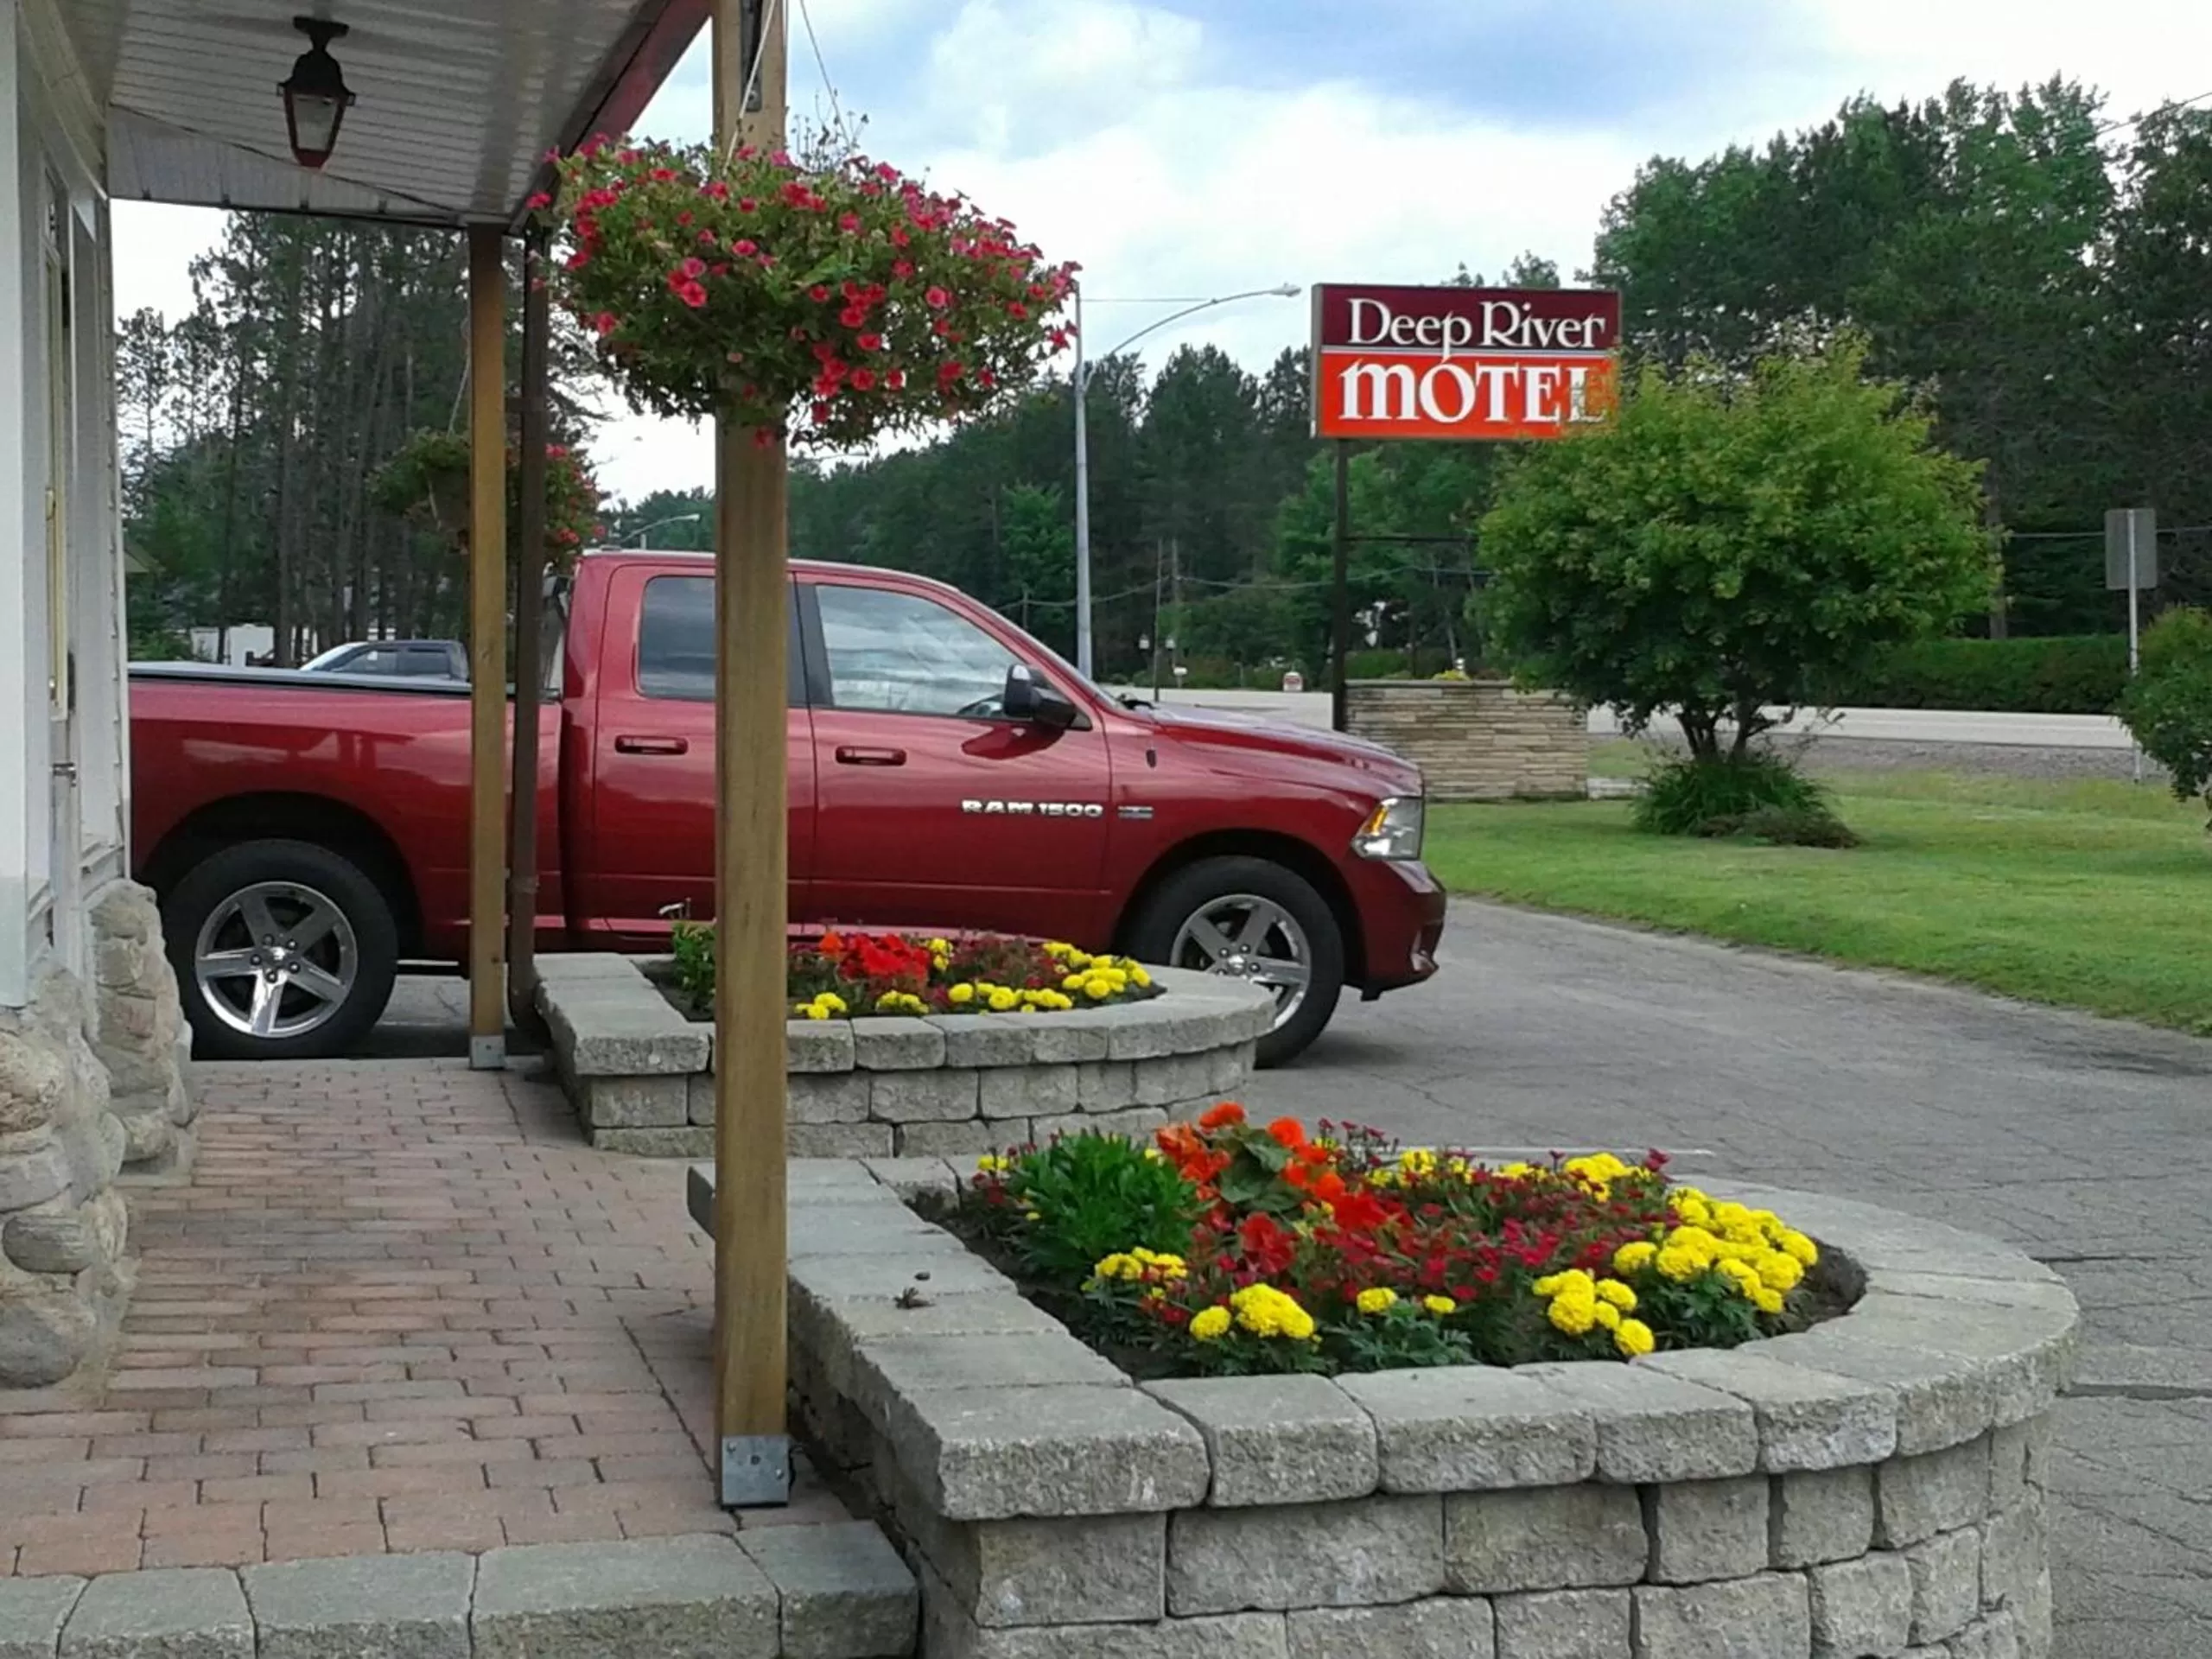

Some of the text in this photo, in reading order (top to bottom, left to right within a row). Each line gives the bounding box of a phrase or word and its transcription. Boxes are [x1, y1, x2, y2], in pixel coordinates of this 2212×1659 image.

[1346, 297, 1605, 361] Deep River
[962, 800, 1033, 815] RAM
[1039, 803, 1103, 817] 1500
